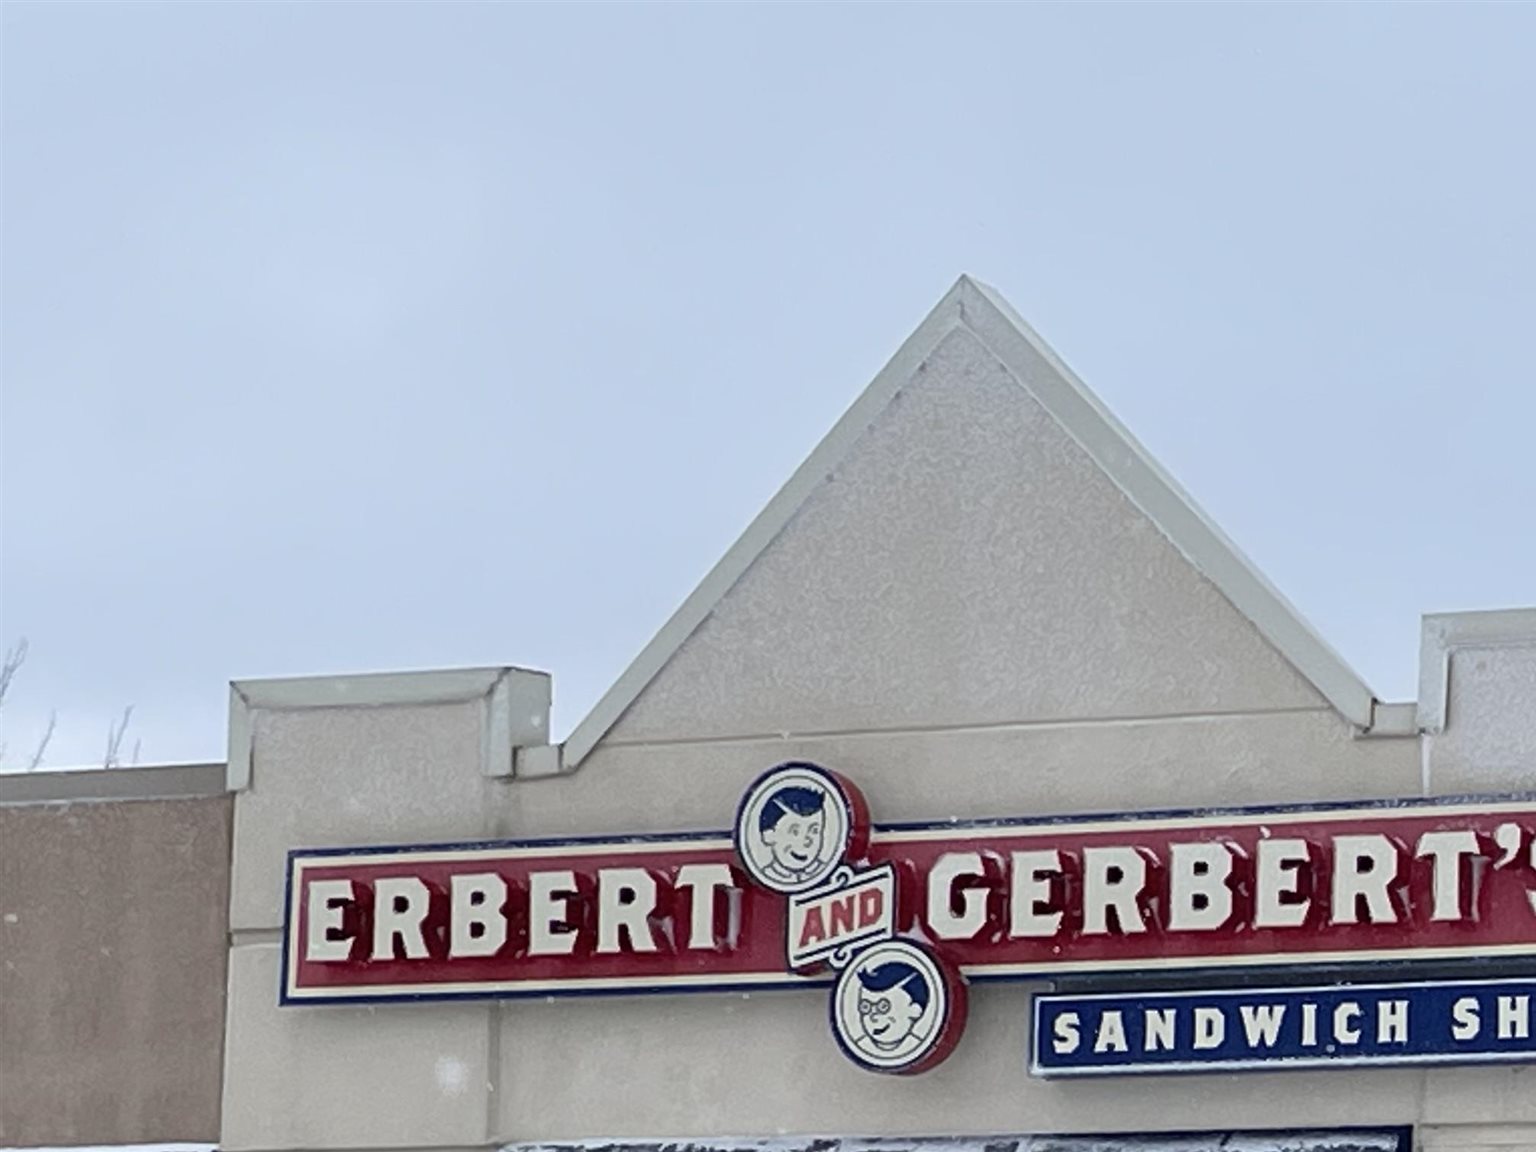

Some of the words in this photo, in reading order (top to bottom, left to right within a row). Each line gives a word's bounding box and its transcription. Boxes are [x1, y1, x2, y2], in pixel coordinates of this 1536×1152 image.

[305, 863, 733, 962] ERBERT
[798, 887, 884, 949] AND
[1052, 1000, 1410, 1056] SANDWICH
